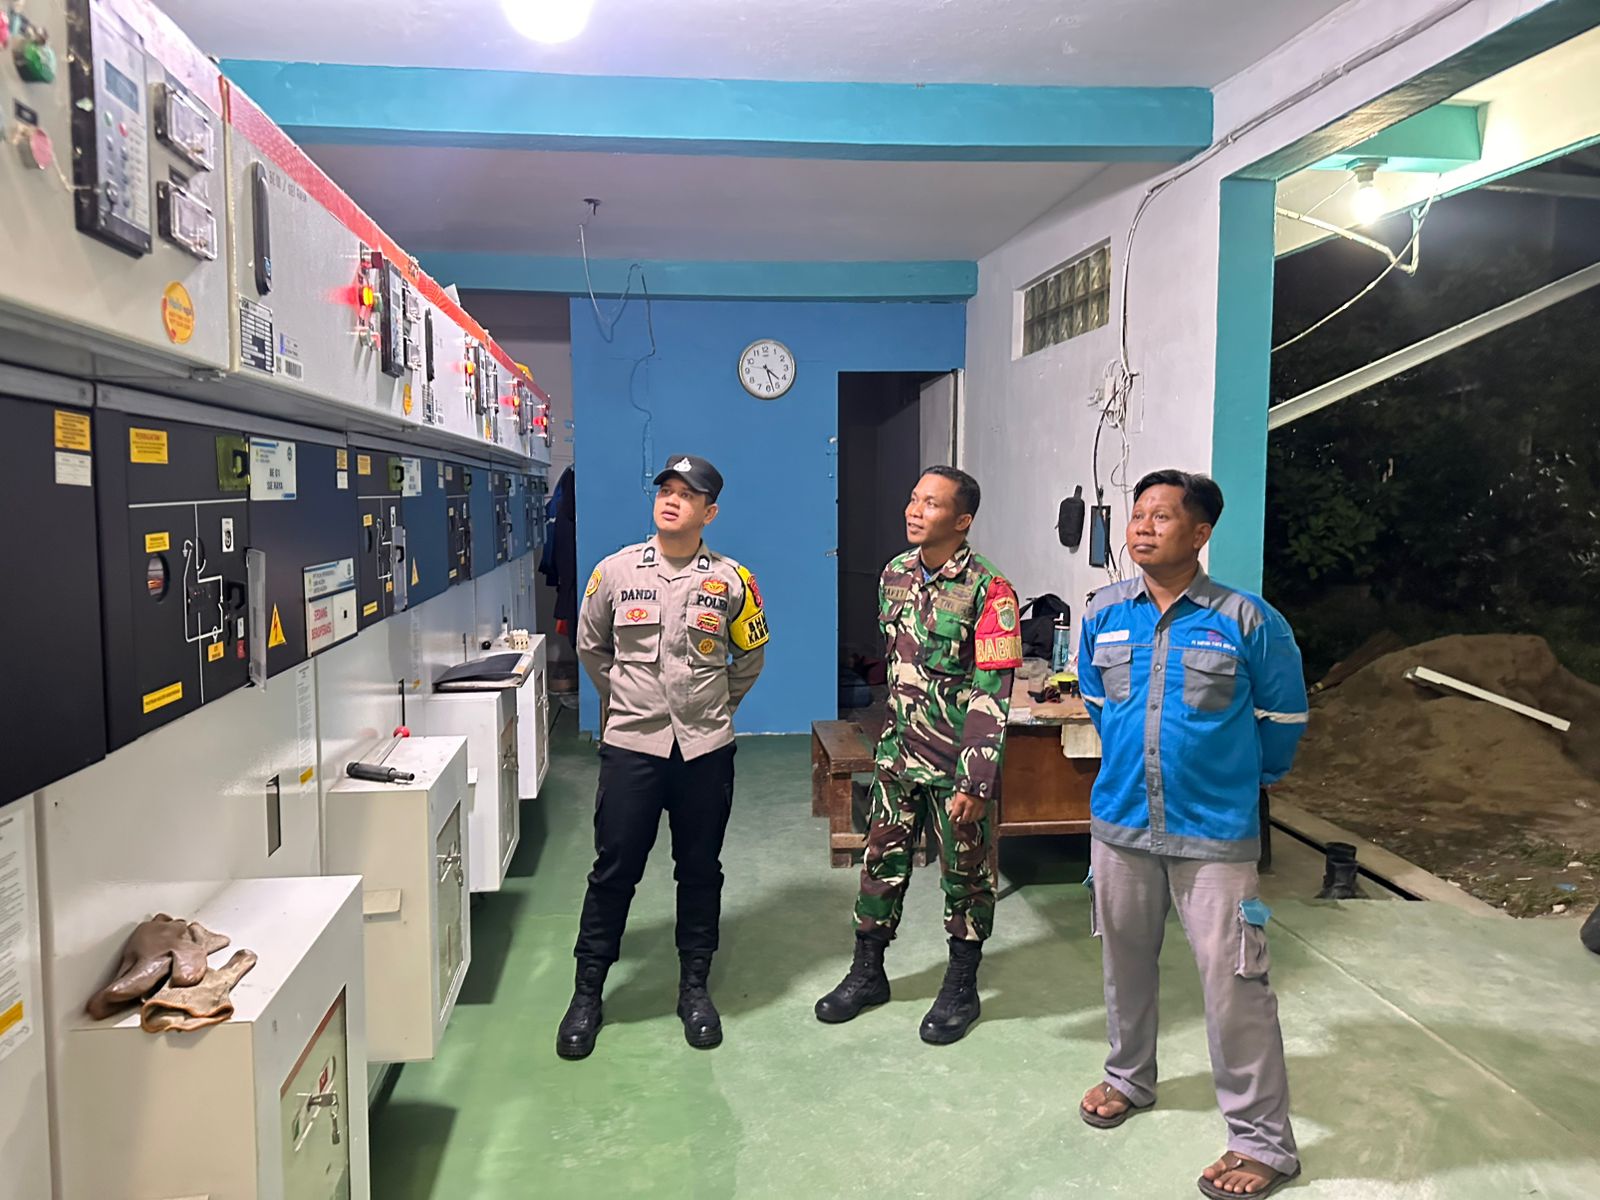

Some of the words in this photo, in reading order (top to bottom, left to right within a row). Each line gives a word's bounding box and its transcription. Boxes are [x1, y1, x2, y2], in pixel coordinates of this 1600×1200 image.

[745, 367, 750, 375] 9
[784, 364, 789, 372] 3
[765, 384, 771, 392] 6
[775, 382, 780, 390] 5
[621, 589, 657, 602] DANDI
